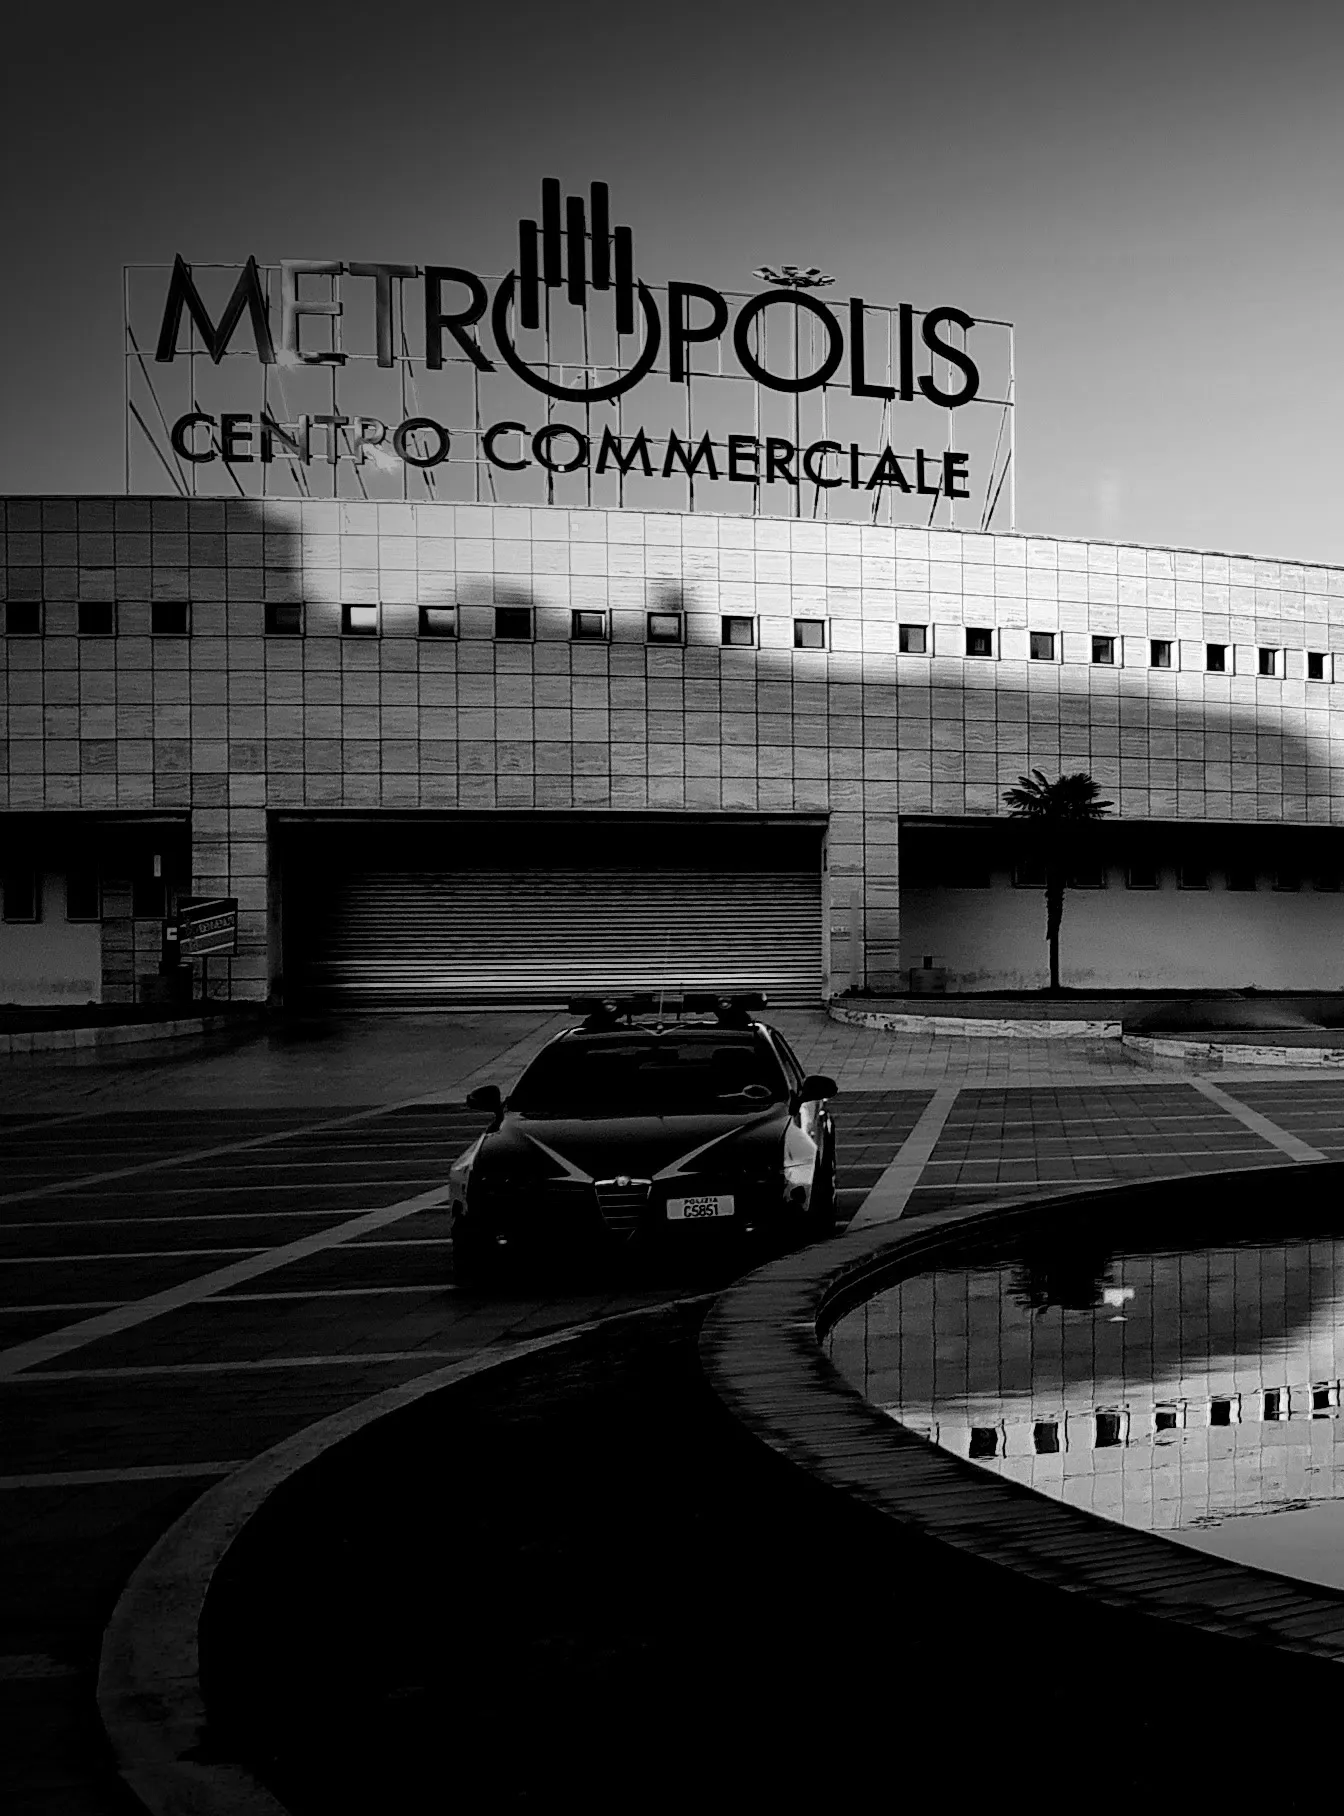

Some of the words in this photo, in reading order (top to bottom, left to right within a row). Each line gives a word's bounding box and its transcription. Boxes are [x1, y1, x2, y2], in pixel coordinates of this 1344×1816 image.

[154, 252, 981, 409] METROPOLIS
[171, 411, 451, 469] CENTRO
[483, 421, 970, 499] COMMERCIALE
